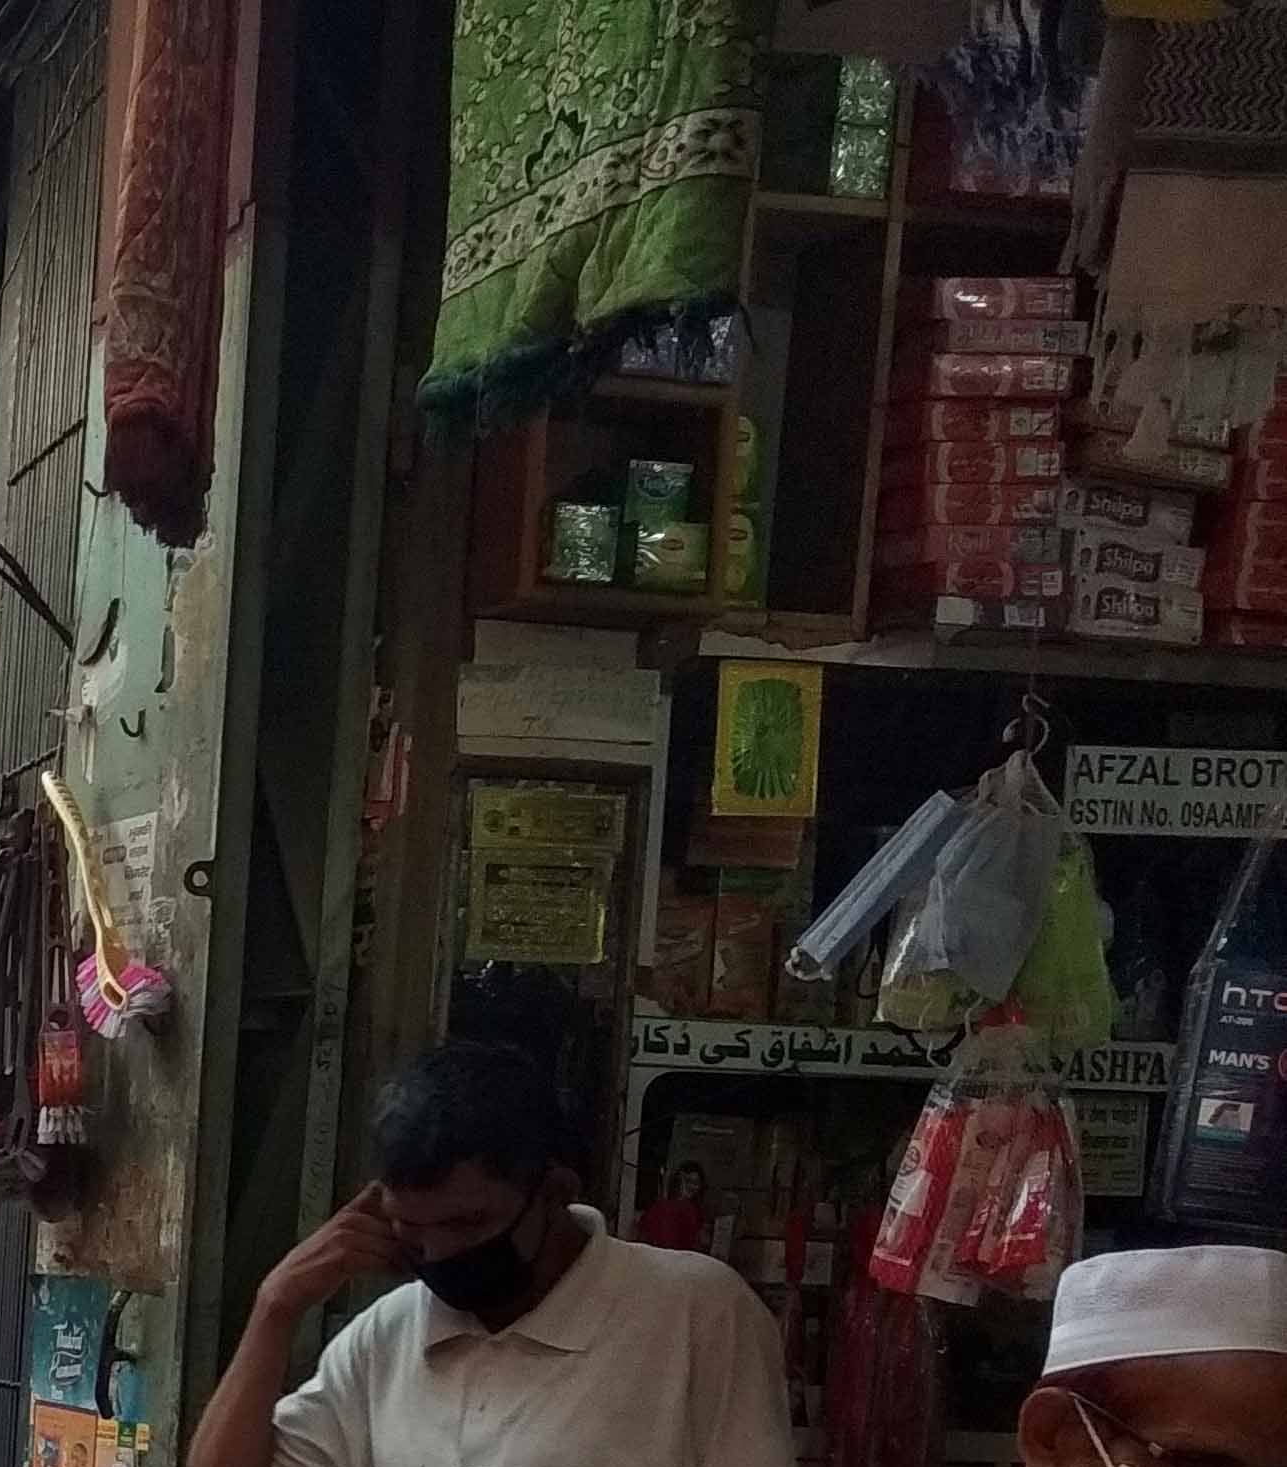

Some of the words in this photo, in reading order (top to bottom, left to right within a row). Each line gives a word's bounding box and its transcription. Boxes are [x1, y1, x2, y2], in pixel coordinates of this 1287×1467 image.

[1074, 753, 1180, 787] AFZAL
[1192, 756, 1285, 789] BROT
[1069, 798, 1133, 827] GSTIN
[1140, 800, 1173, 828] No.
[1067, 1048, 1168, 1085] ASHFA
[1207, 1048, 1271, 1071] MAN'S
